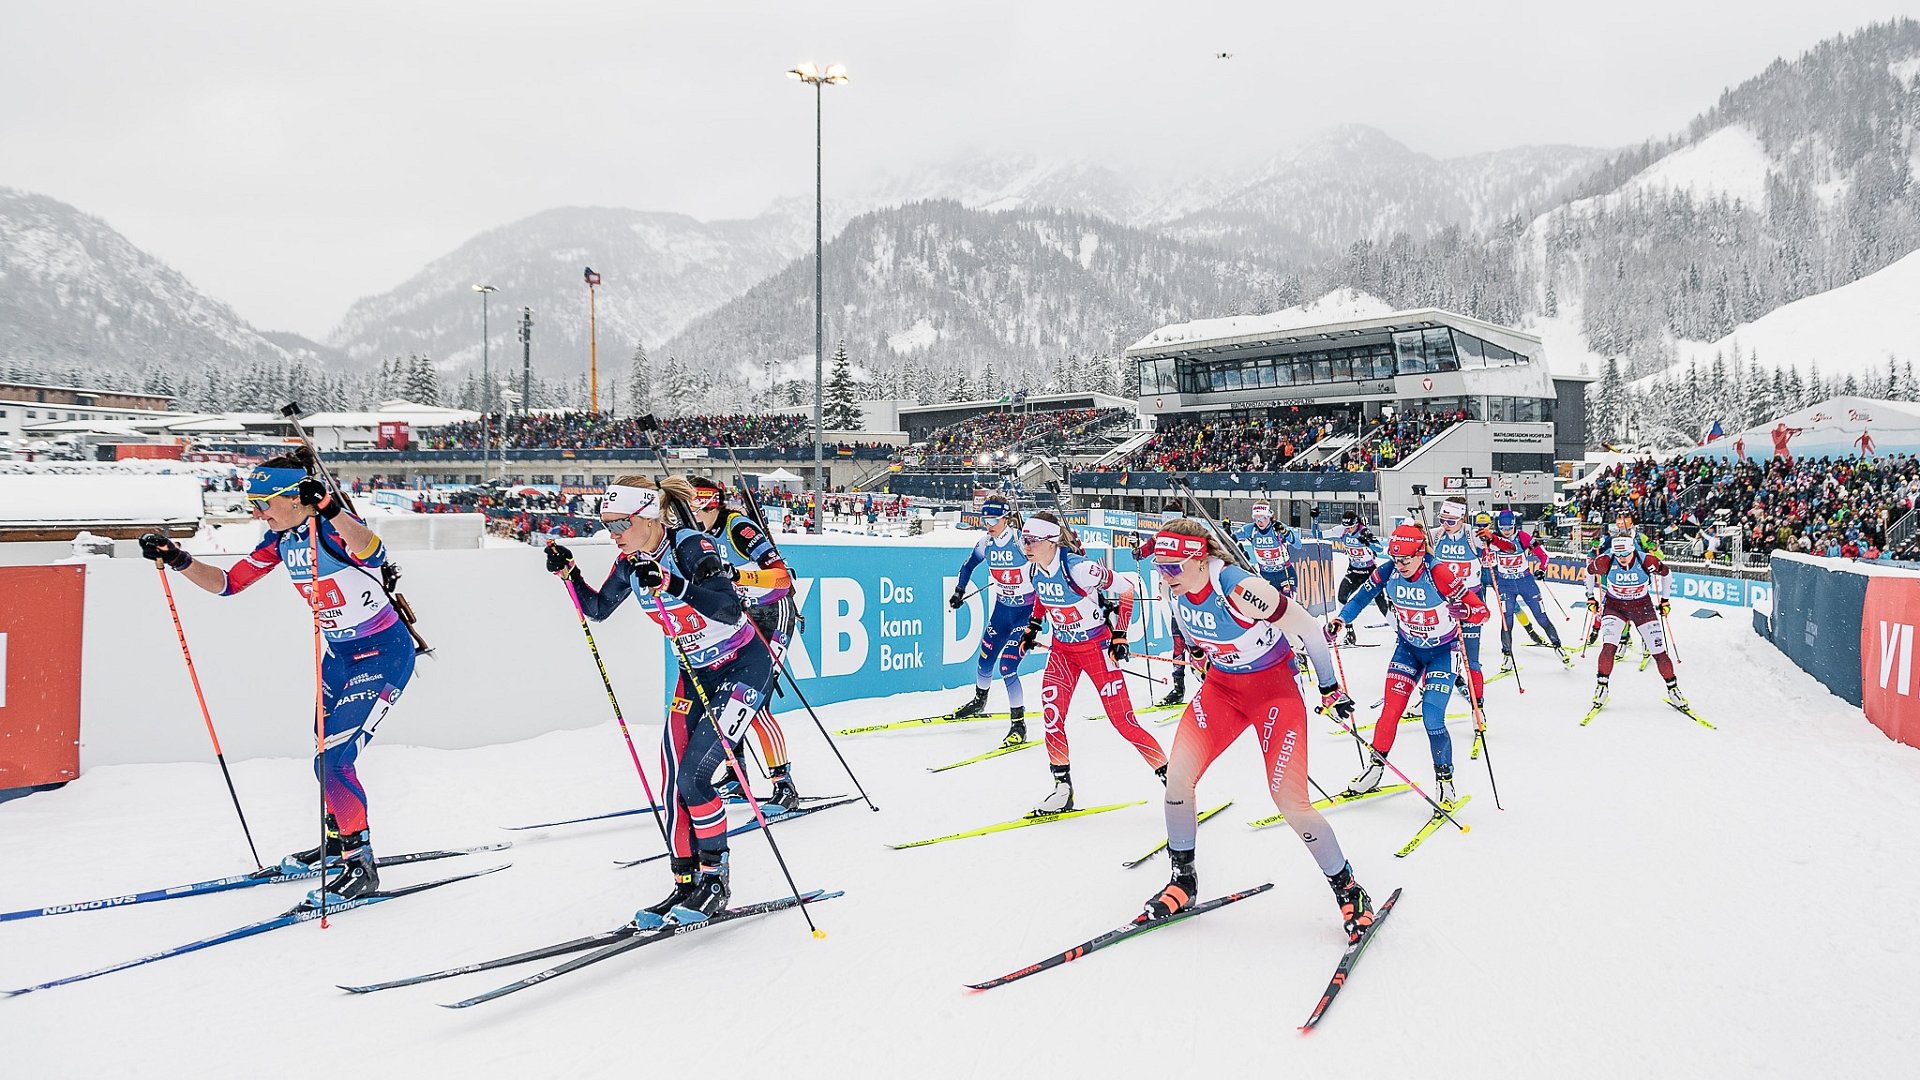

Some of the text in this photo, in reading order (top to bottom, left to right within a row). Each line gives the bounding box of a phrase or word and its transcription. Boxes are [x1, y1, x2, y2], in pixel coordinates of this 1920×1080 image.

[1256, 536, 1274, 545] DKB
[990, 550, 1014, 561] DKB
[1442, 545, 1466, 555] DKB
[1002, 570, 1012, 583] 4
[1615, 572, 1639, 582] DKB
[327, 590, 340, 605] 1
[1037, 581, 1065, 597] DKB
[1396, 585, 1427, 601] DKB
[1684, 578, 1726, 600] DKB
[361, 590, 374, 607] 2
[1242, 590, 1270, 613] BKW
[687, 614, 699, 629] 1
[1092, 608, 1100, 620] 6
[1180, 604, 1217, 630] DKB
[785, 576, 869, 681] KB
[879, 576, 914, 604] Das
[879, 611, 922, 638] kann
[879, 644, 924, 672] Bank
[335, 692, 367, 710] RAFT
[372, 706, 389, 732] 2
[728, 707, 748, 737] 3
[1271, 729, 1298, 793] RAIFFEISEN
[269, 869, 328, 884] SALOMON
[42, 894, 137, 916] SALOMON
